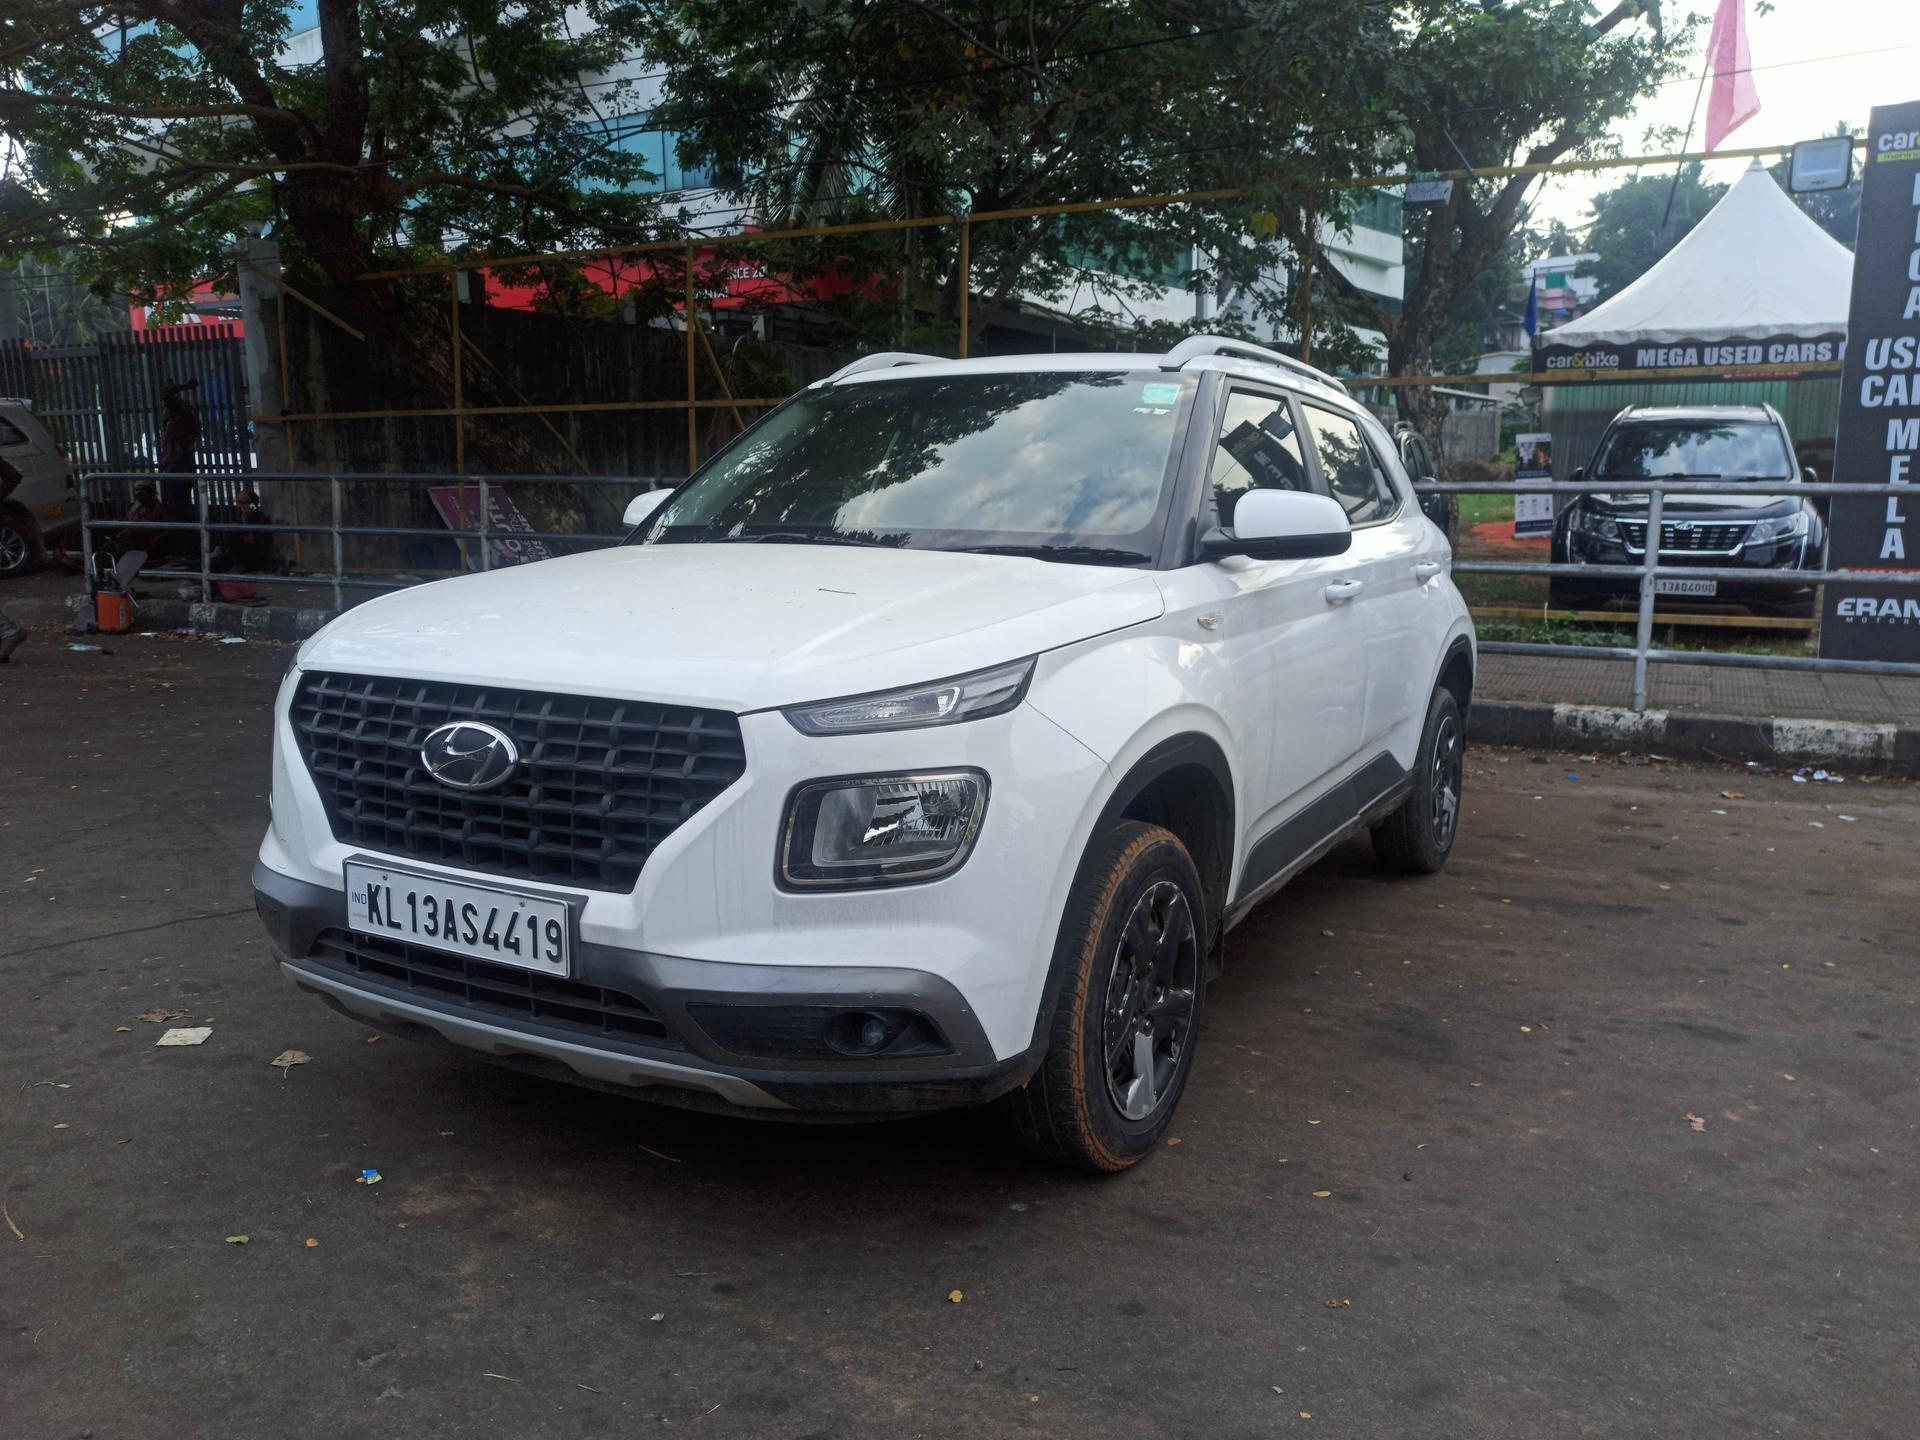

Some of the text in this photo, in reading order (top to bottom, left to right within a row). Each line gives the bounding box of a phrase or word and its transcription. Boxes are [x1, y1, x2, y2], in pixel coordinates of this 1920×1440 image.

[1637, 347, 1698, 368] MEGA
[1704, 345, 1762, 365] USED
[1768, 342, 1832, 363] CARS
[367, 882, 562, 963] KL13AS4419
